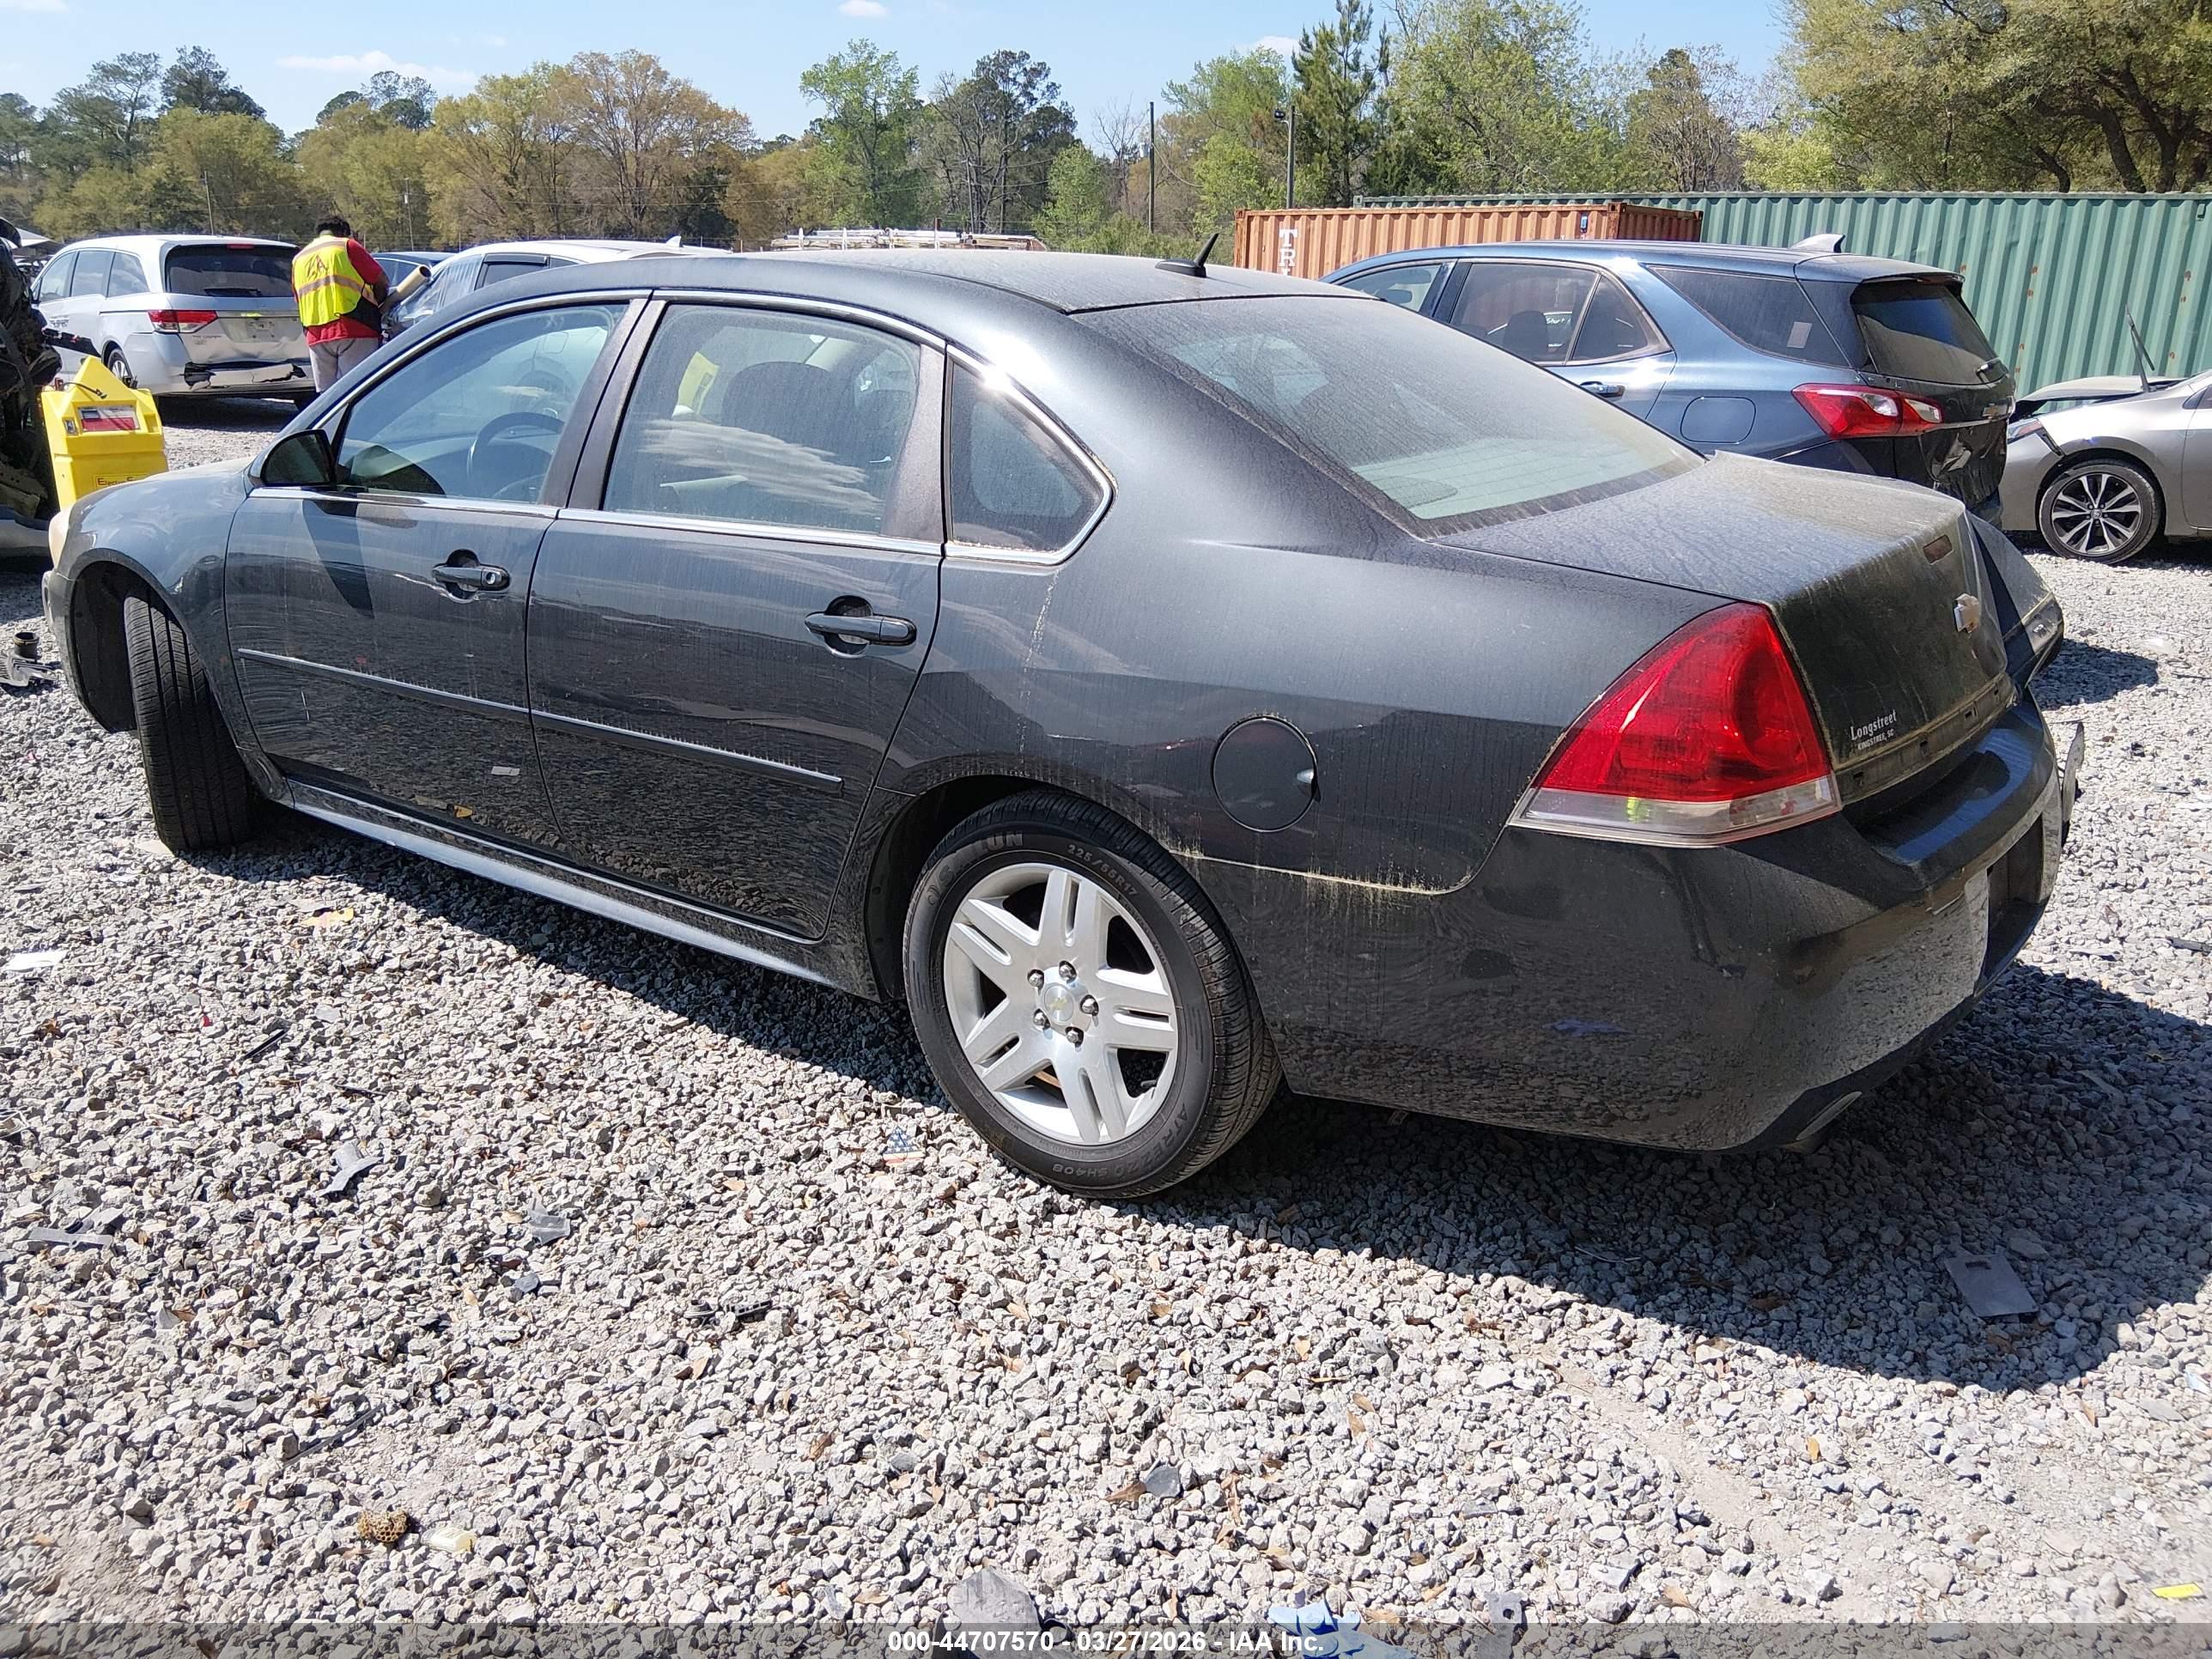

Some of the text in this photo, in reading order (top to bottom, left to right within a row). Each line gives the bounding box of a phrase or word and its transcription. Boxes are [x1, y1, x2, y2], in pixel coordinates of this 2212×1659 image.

[1850, 709, 1897, 741] Longstreet
[1857, 728, 1894, 750] KINGSTREE, SC
